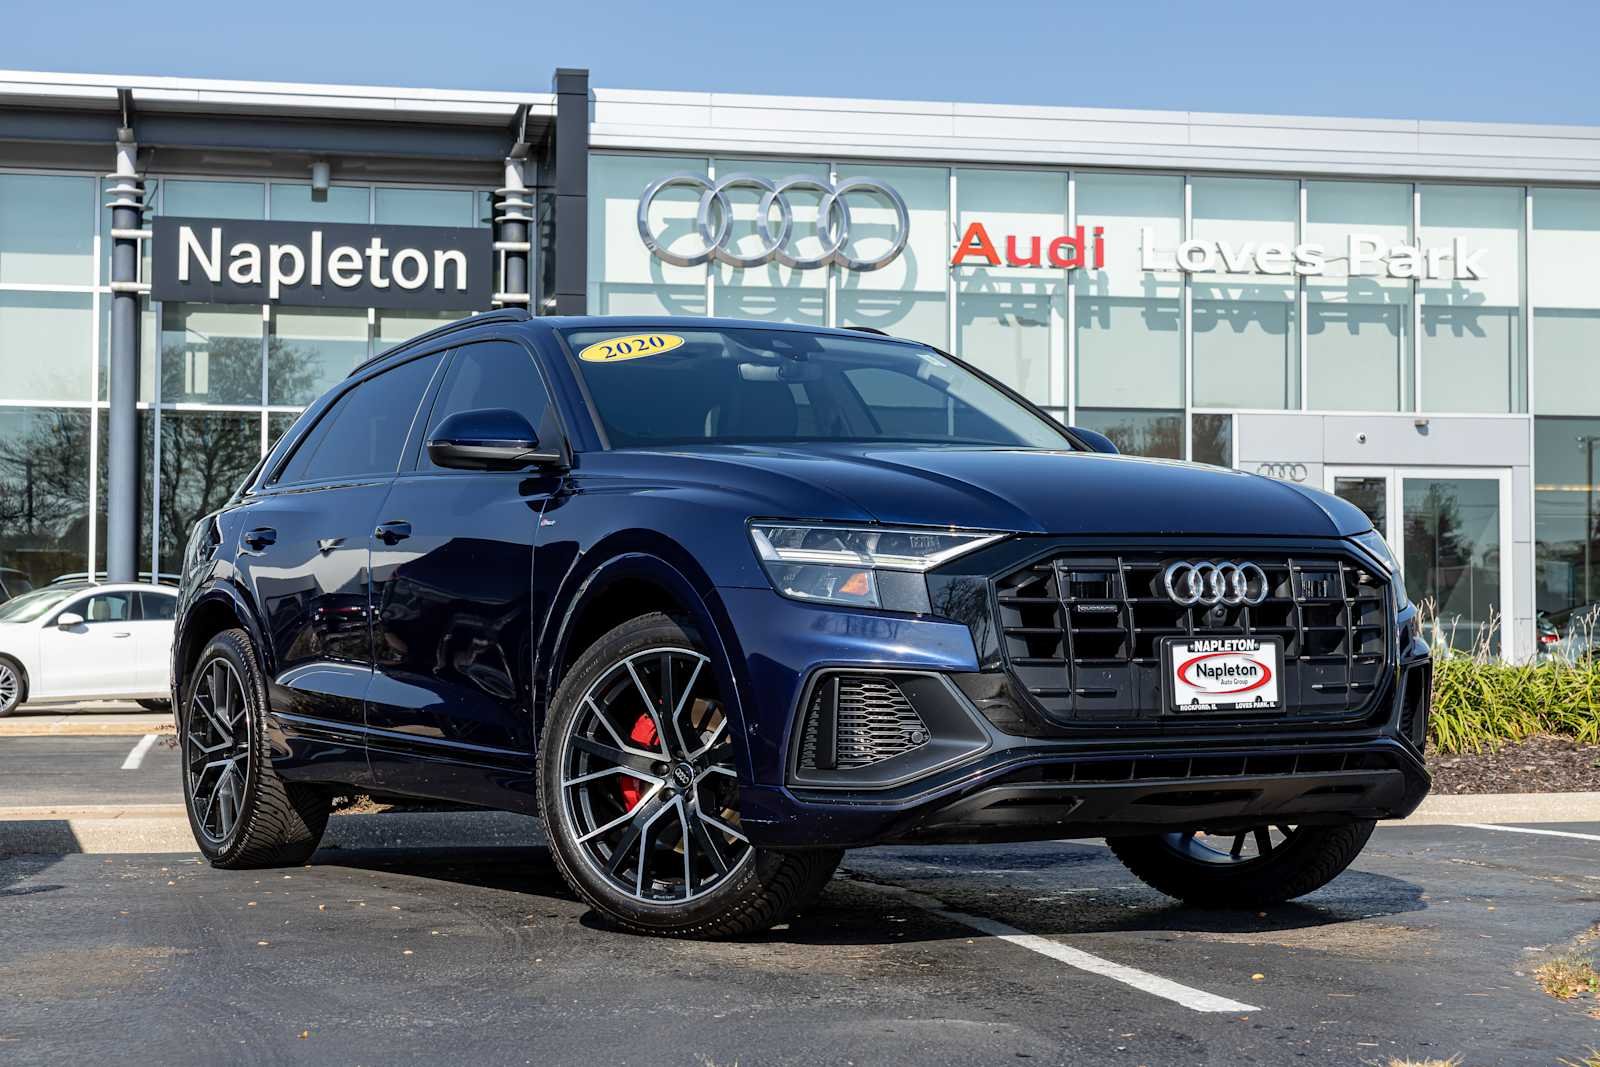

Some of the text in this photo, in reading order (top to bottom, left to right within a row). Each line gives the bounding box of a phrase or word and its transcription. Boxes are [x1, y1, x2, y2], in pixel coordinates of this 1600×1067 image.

[951, 222, 1490, 280] Audi Loves Park
[178, 226, 468, 300] Napleton
[599, 335, 665, 358] 2020
[1194, 639, 1255, 652] NAPLETON
[1196, 662, 1257, 680] Napleton
[1220, 678, 1248, 686] Auto Group
